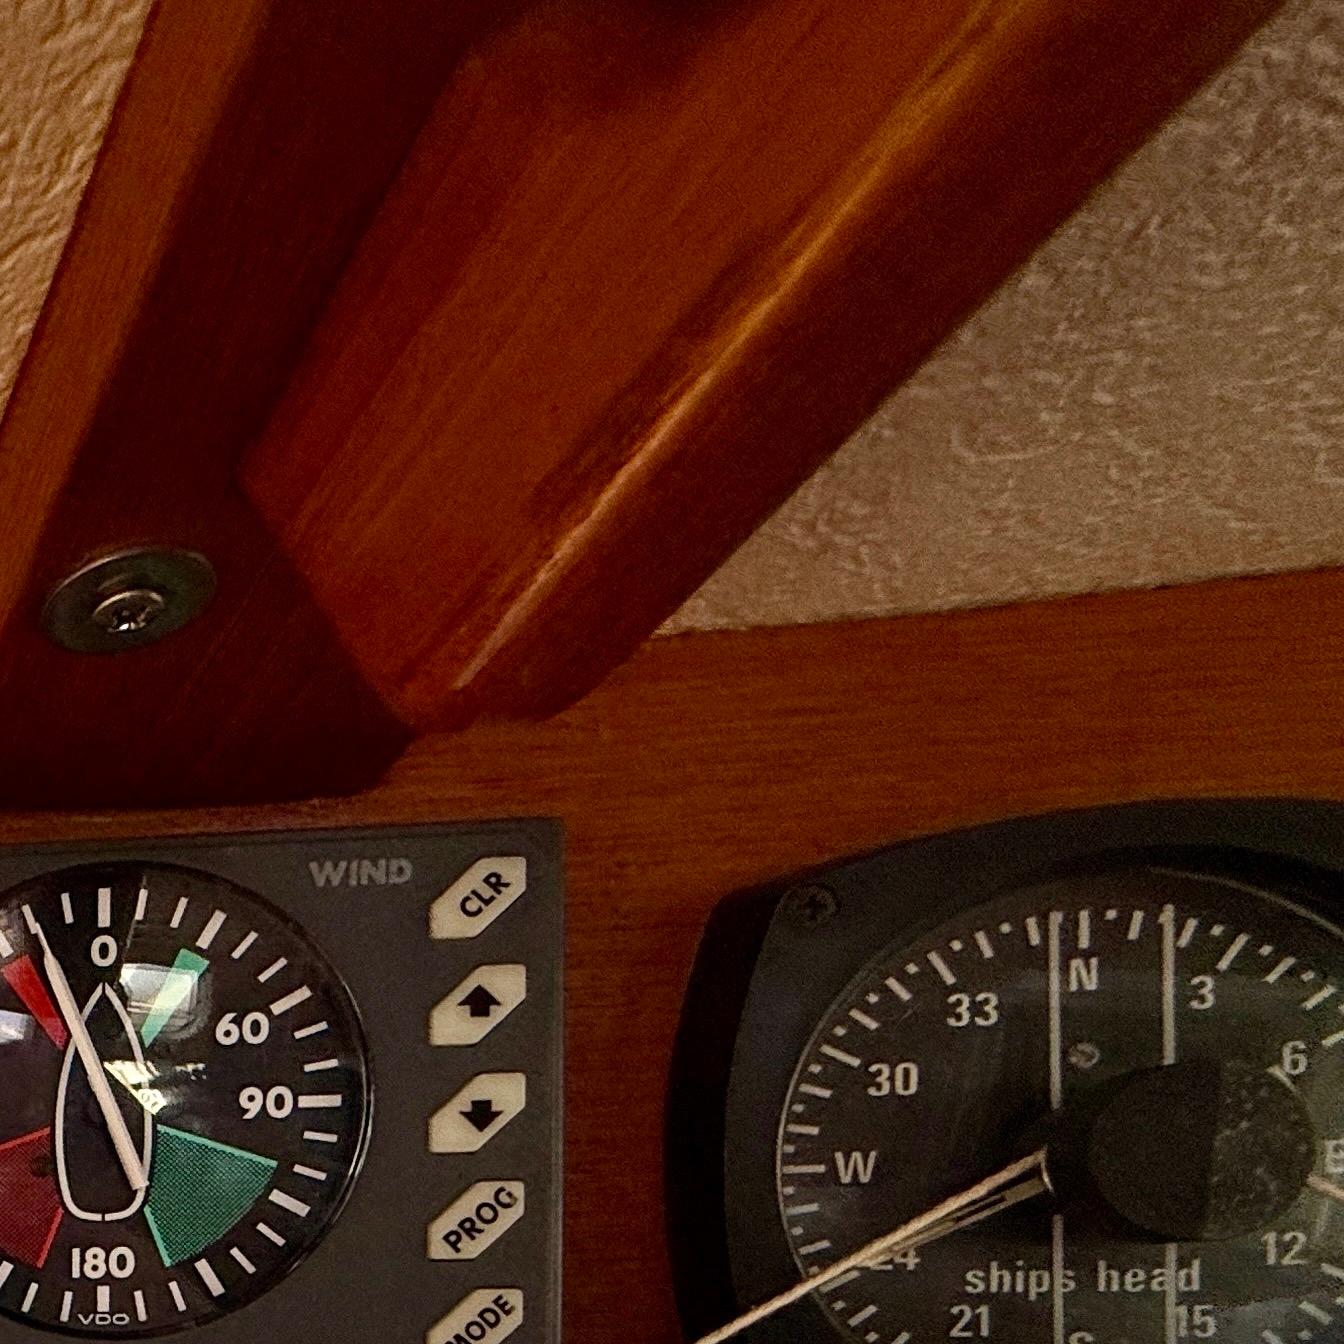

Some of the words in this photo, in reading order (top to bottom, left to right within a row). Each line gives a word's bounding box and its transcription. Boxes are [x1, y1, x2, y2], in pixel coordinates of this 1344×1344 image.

[309, 858, 412, 887] WIND
[460, 870, 511, 919] CLR
[90, 936, 117, 966] 0
[1069, 958, 1098, 992] N
[947, 993, 999, 1027] 33
[1189, 977, 1215, 1010] 3
[214, 1011, 270, 1045] 60
[1282, 1041, 1308, 1075] 6
[868, 1063, 919, 1097] 30
[238, 1087, 294, 1119] 90
[835, 1151, 877, 1184] W
[442, 1186, 518, 1254] PROG
[70, 1247, 136, 1279] 180
[1261, 1231, 1308, 1266] 12
[964, 1260, 1077, 1300] ships
[1096, 1258, 1201, 1293] head
[77, 1313, 130, 1326] VDO
[949, 1304, 991, 1338] 21
[1174, 1304, 1217, 1339] 15
